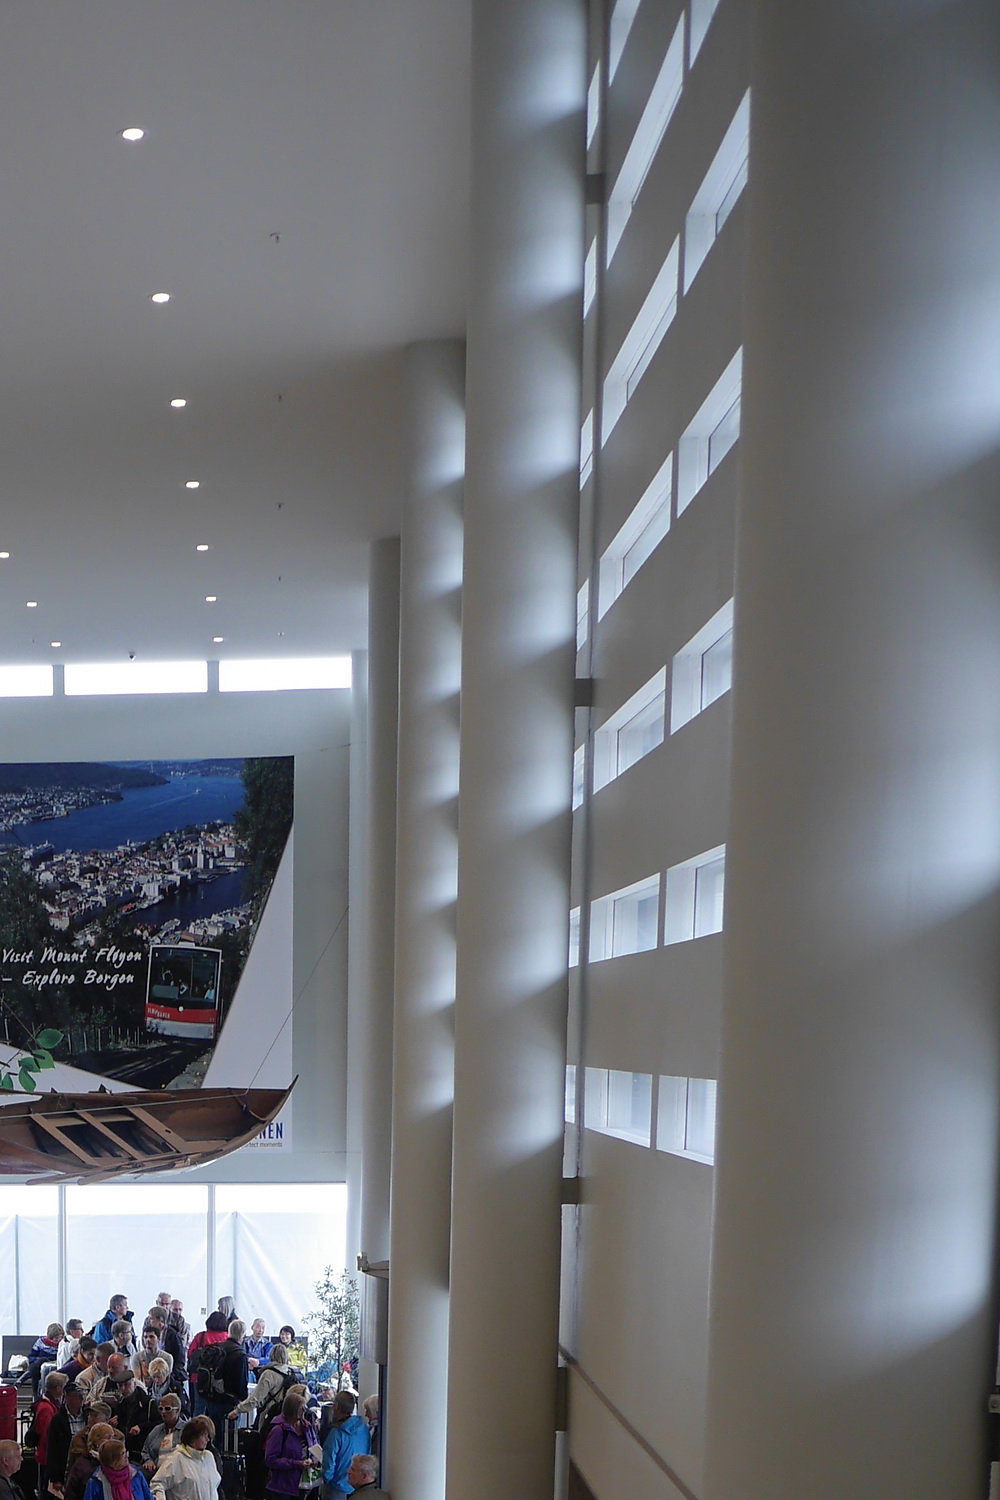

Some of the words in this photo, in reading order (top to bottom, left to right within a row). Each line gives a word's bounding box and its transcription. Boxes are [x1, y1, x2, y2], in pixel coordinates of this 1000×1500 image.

[1, 947, 34, 963] Visit
[40, 945, 88, 964] Mount
[21, 967, 76, 991] Explore
[83, 968, 135, 991] Bergen
